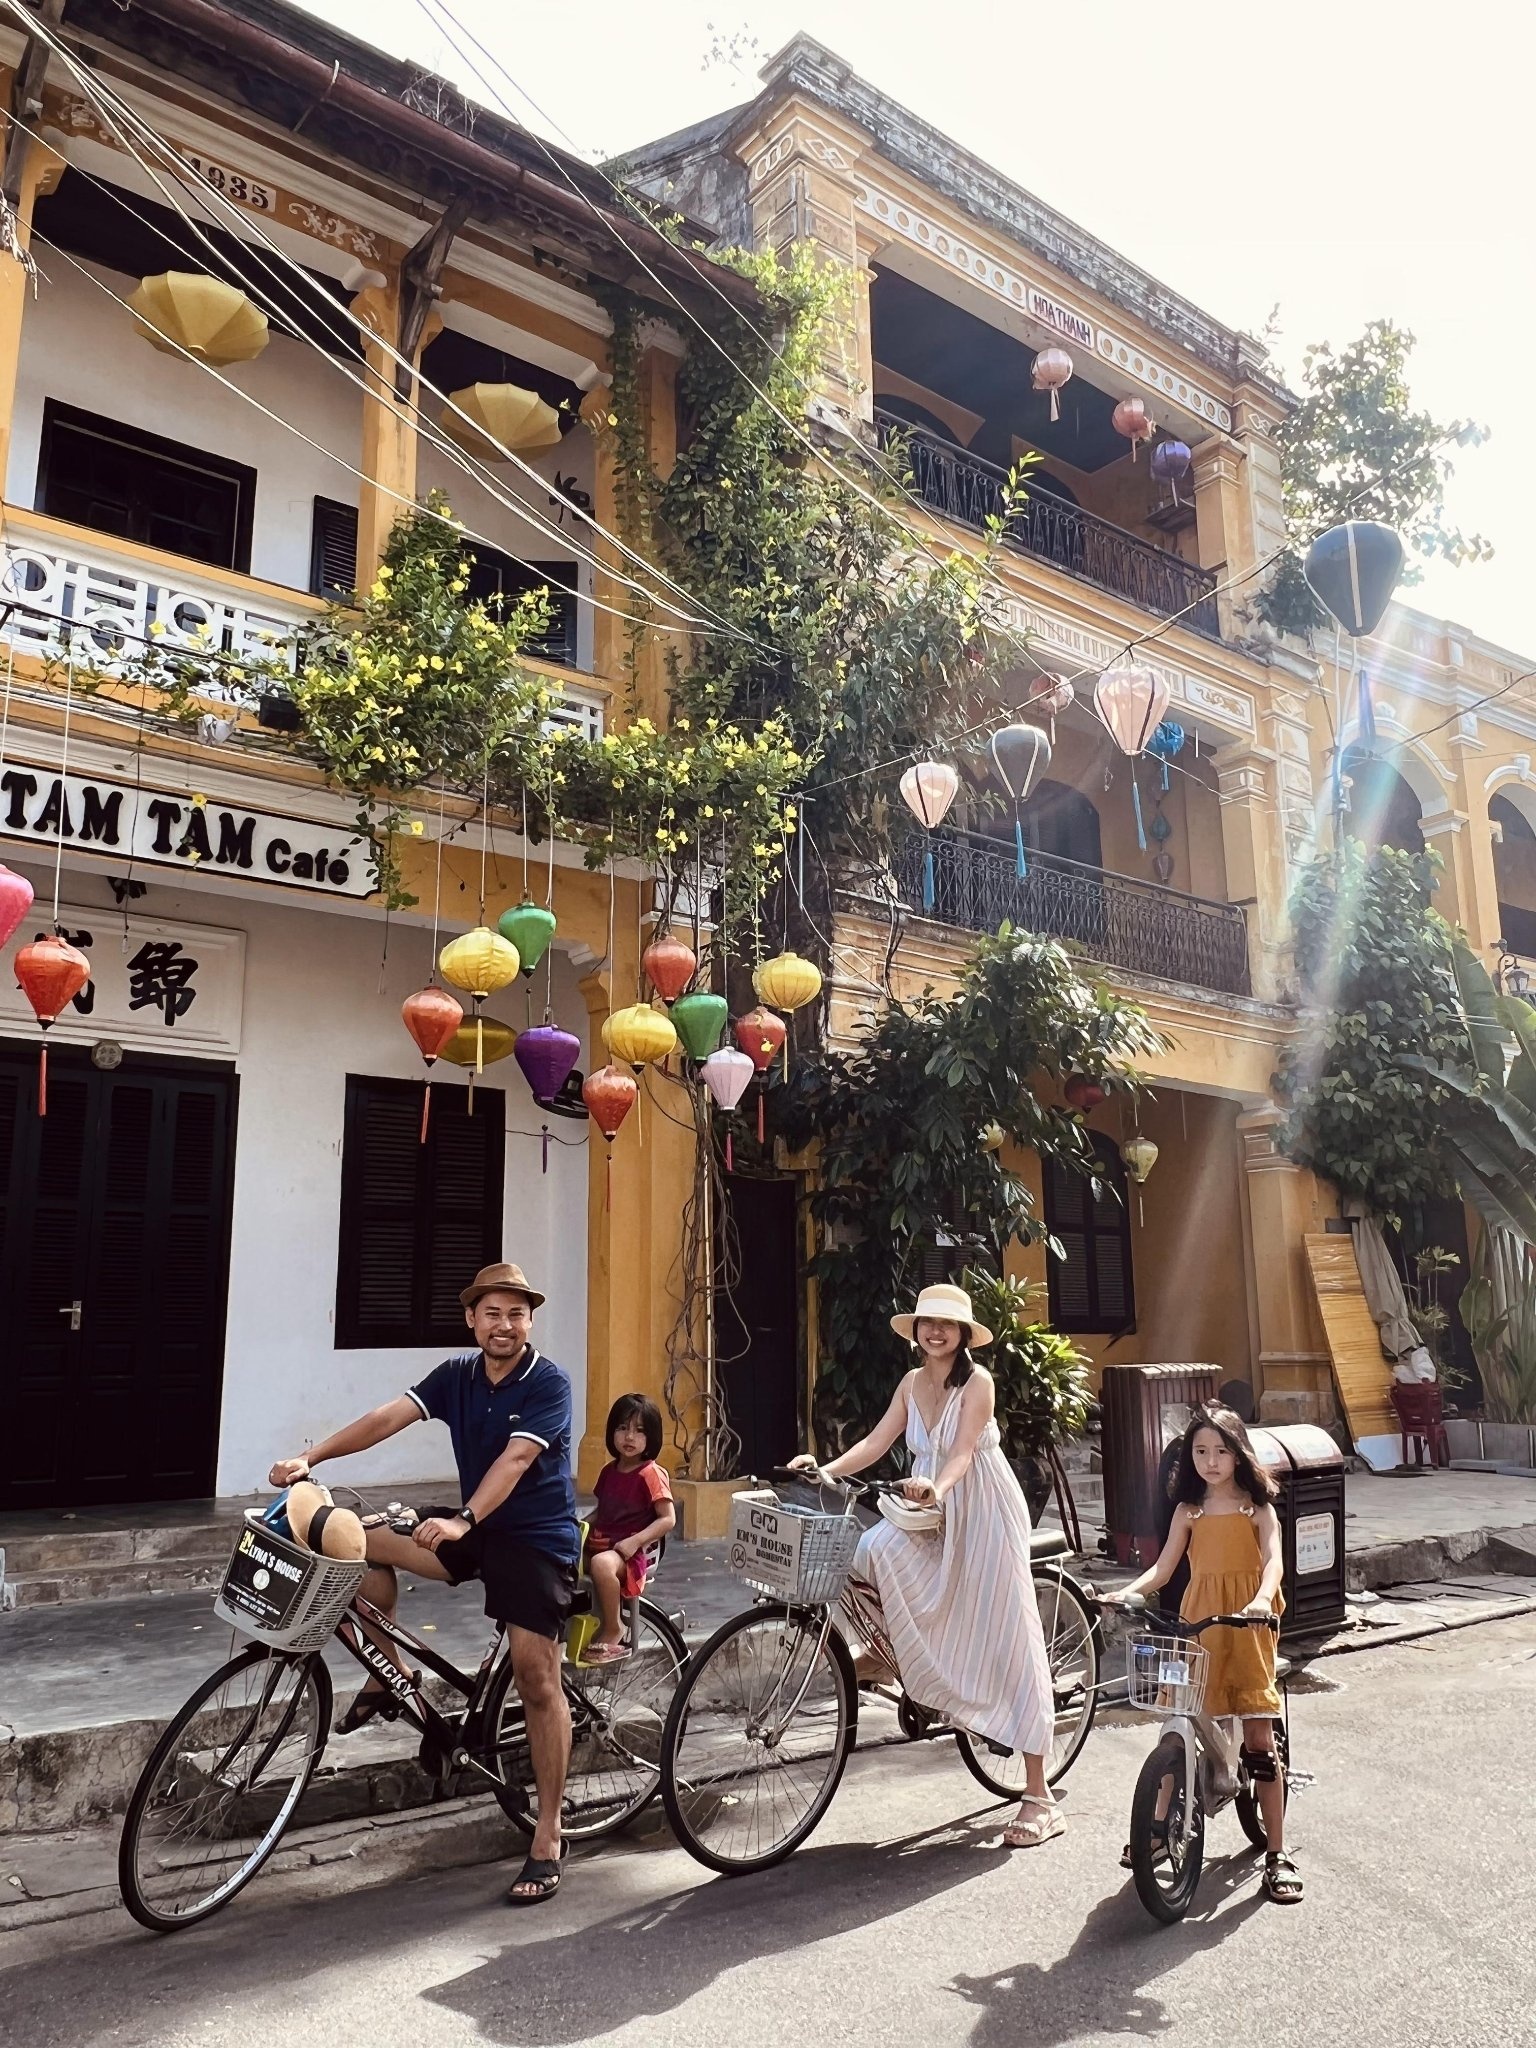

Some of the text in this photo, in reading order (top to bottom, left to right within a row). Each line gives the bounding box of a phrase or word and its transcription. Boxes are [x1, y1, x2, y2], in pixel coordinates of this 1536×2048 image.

[191, 158, 268, 209] 1935
[1056, 307, 1092, 346] THANH
[1, 770, 350, 886] TAM TAM Café
[755, 1548, 792, 1568] HOMESTAY
[760, 1536, 793, 1557] HOUSE
[274, 1558, 303, 1583] HOUSE
[362, 1643, 416, 1696] LUCKY
